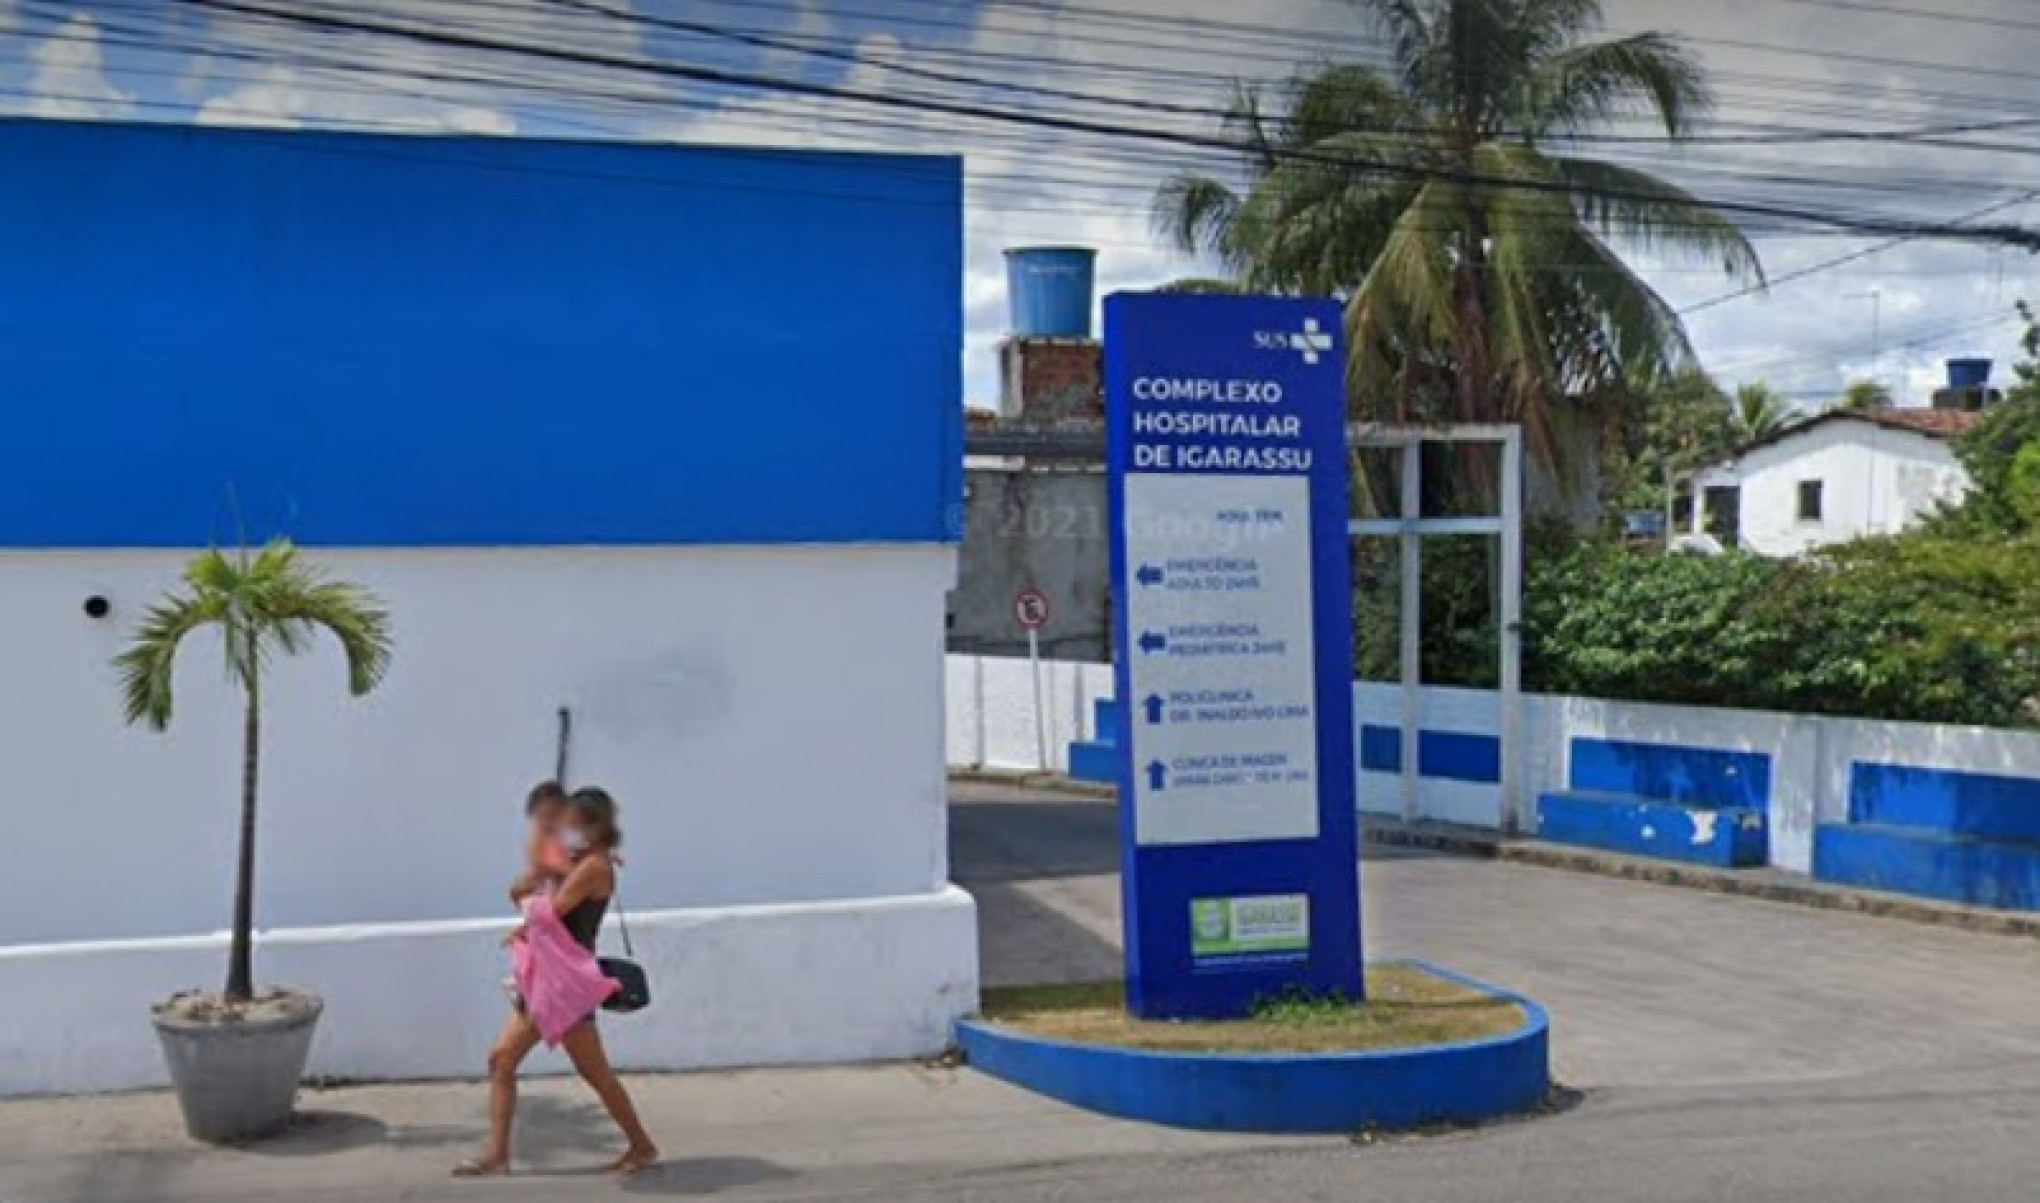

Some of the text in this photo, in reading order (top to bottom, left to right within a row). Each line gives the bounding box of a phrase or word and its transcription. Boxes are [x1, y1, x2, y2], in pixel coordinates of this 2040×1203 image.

[1133, 377, 1283, 403] COMPLEXO
[1133, 411, 1301, 437] HOSPITALAR
[1133, 445, 1312, 469] DE IGARASSU
